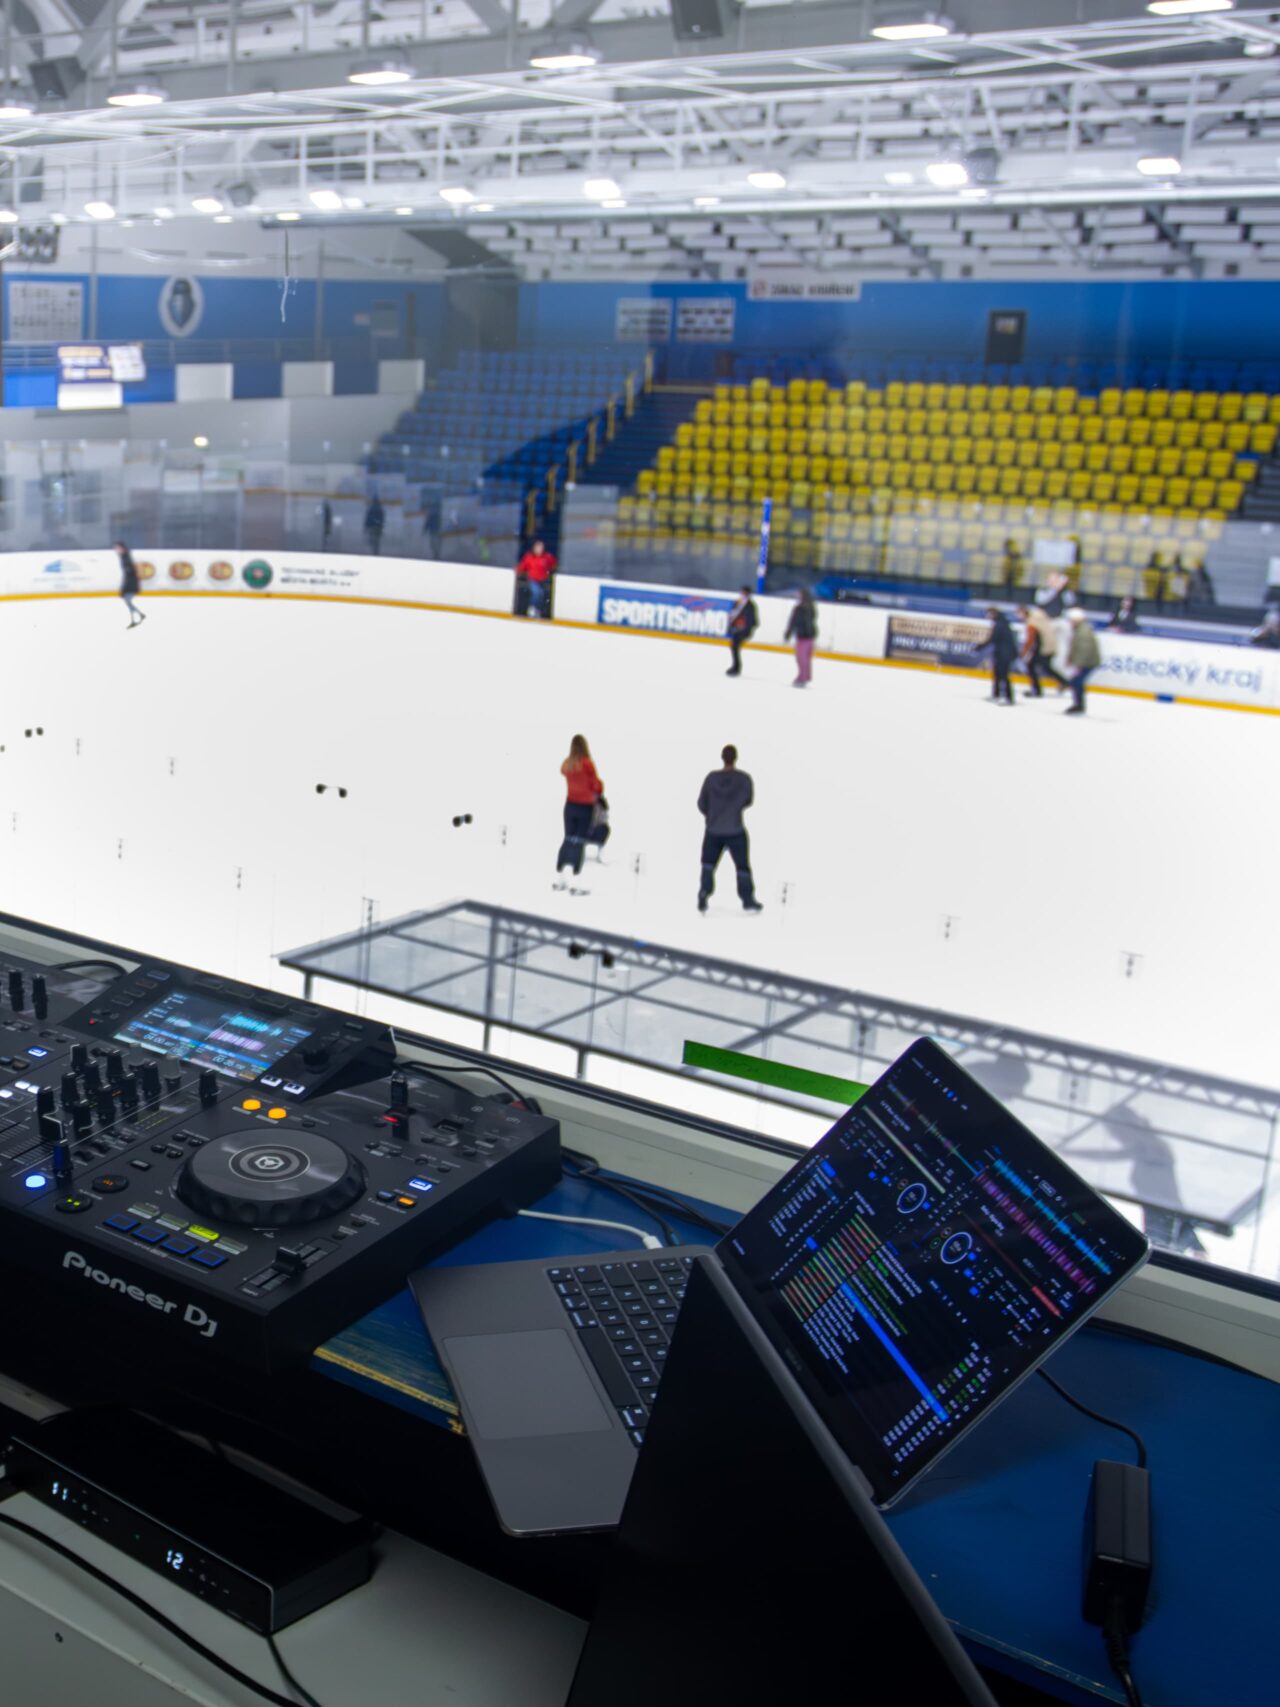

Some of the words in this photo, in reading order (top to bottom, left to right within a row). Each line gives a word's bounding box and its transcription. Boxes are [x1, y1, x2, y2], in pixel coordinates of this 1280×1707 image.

[601, 597, 729, 638] SPORTISIMO
[1100, 655, 1200, 686] stecký
[1206, 662, 1262, 693] kraj
[62, 1250, 178, 1314] Pioneer
[51, 1481, 69, 1501] 11
[166, 1549, 184, 1570] 12
